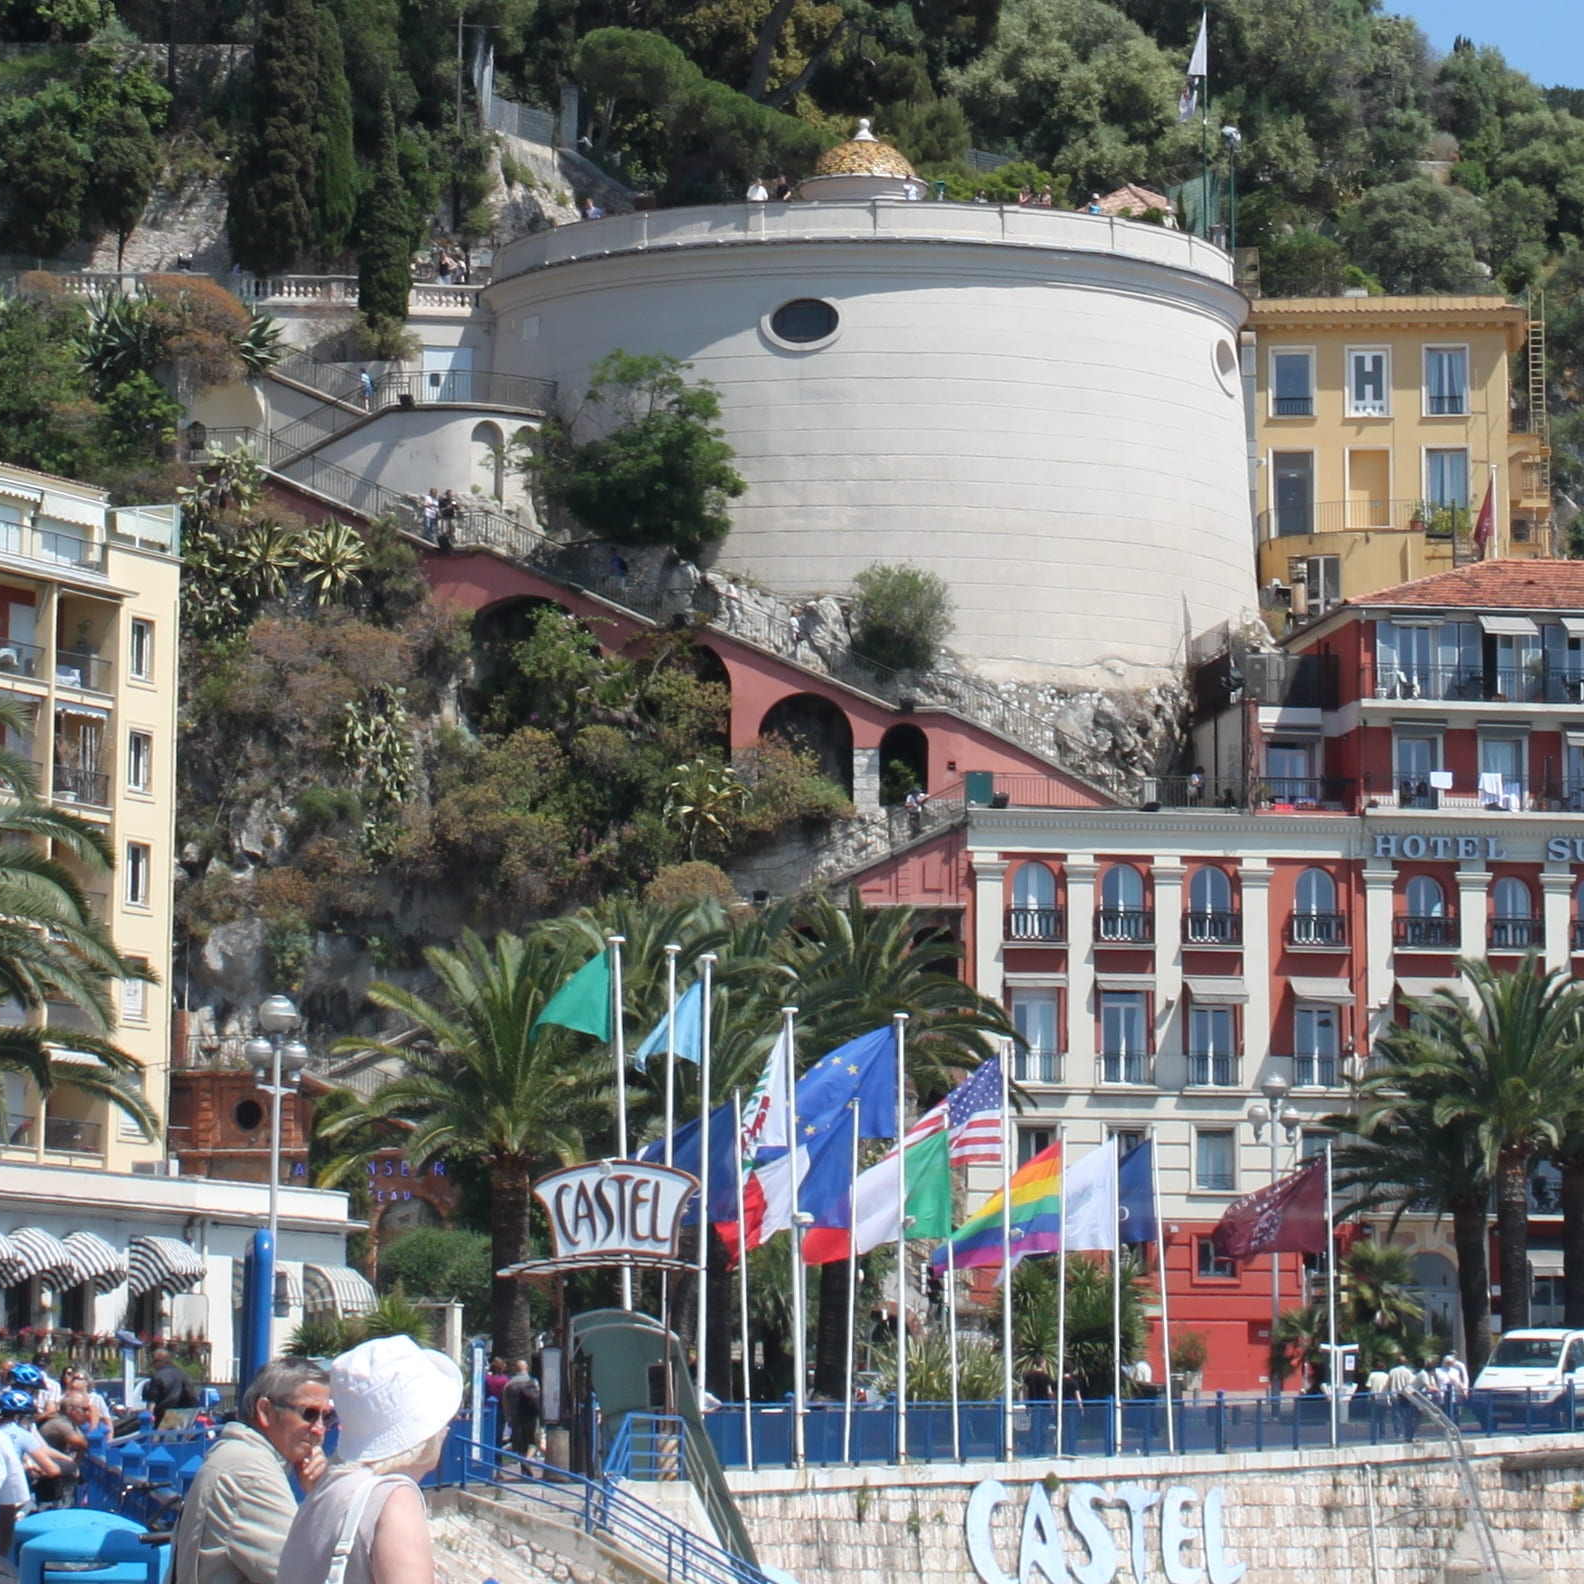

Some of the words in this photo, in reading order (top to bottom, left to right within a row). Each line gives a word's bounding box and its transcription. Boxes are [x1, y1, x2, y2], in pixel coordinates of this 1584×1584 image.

[1354, 355, 1384, 401] H
[1373, 834, 1507, 860] HOTEL
[554, 1174, 669, 1246] CASTEL
[965, 1479, 1247, 1584] CASTEL
